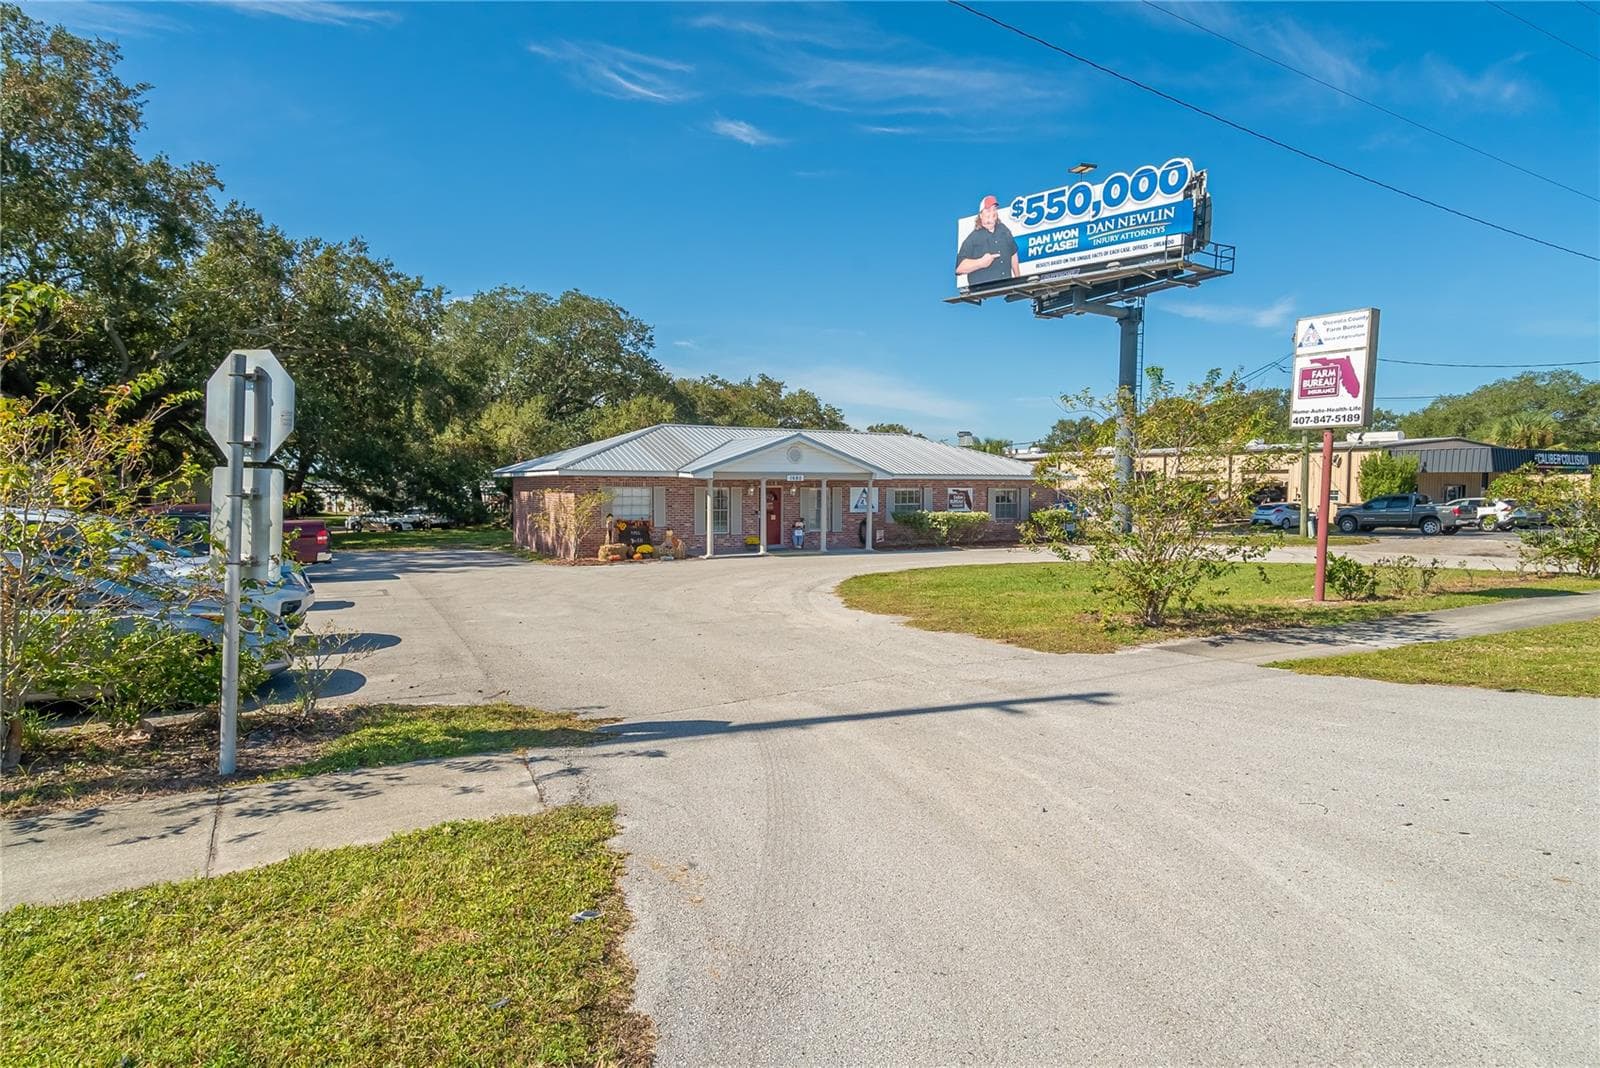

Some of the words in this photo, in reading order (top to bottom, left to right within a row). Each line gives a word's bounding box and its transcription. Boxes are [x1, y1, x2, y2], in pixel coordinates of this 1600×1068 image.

[1011, 160, 1189, 226] $550,000
[1086, 219, 1115, 236] DAN
[1117, 206, 1176, 227] NEWLIN
[1028, 233, 1052, 247] DAN
[1053, 228, 1079, 243] WON
[1093, 233, 1120, 246] INJURY
[1120, 226, 1166, 241] ATTORNEYS
[1028, 244, 1044, 257] MY
[1045, 238, 1079, 253] CASE!!
[1343, 323, 1365, 331] Bureau
[1302, 377, 1337, 388] BUREAU
[1311, 368, 1337, 378] FARM
[1292, 413, 1361, 425] 407-847-5189
